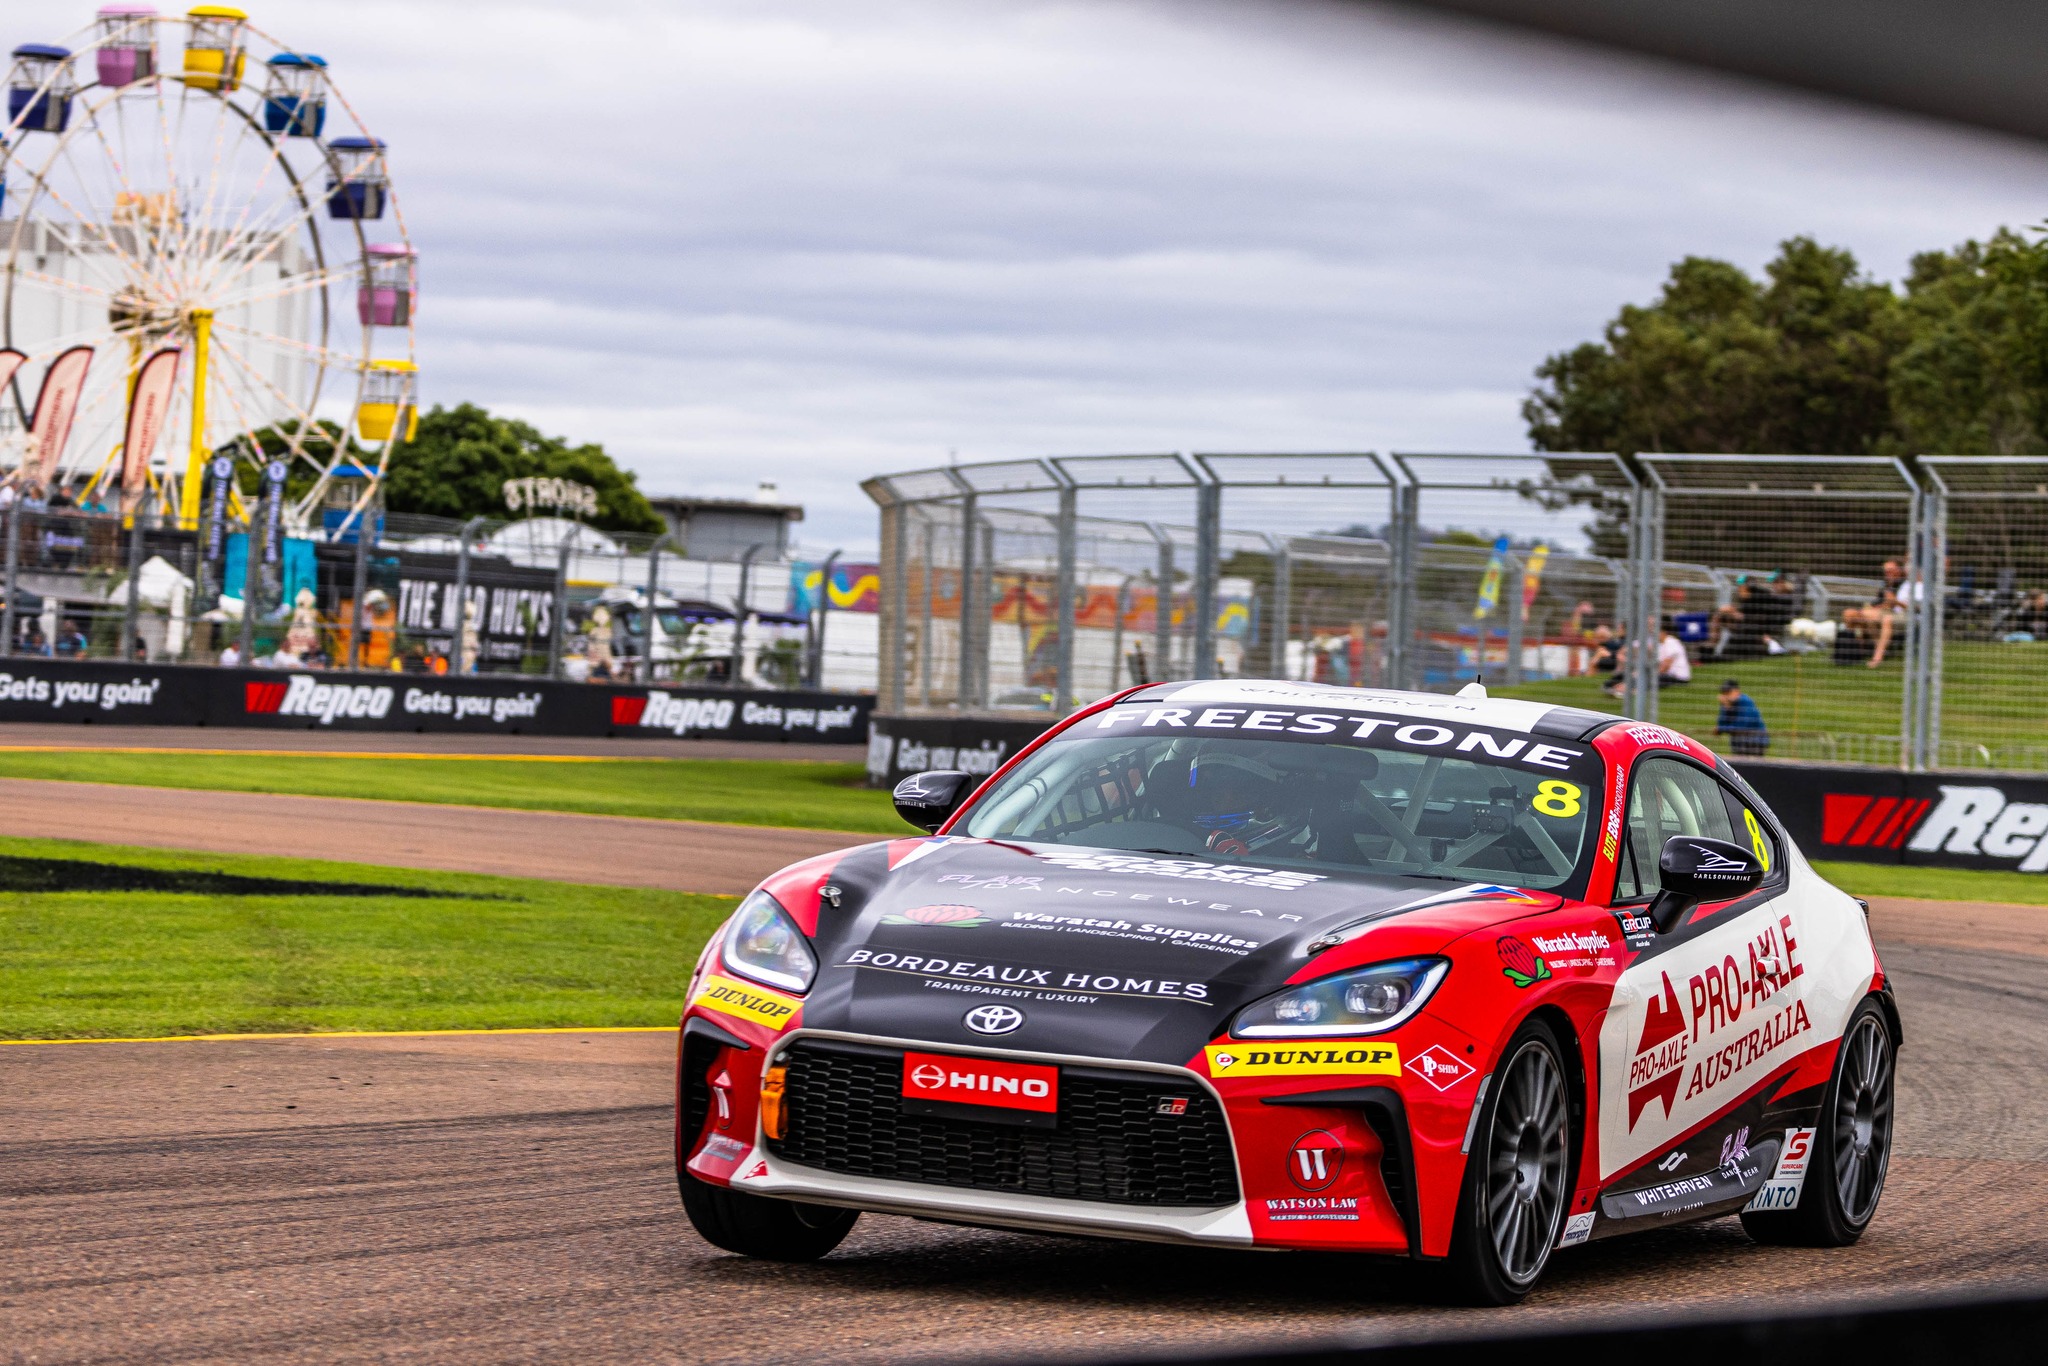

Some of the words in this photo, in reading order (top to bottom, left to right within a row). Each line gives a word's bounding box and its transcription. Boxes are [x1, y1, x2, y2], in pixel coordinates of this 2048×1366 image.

[398, 579, 438, 629] THE
[0, 673, 50, 700] Gets
[52, 680, 98, 708] you
[279, 674, 394, 725] Repco
[404, 687, 451, 712] Gets
[453, 698, 492, 720] you
[640, 690, 736, 735] Repco
[741, 700, 783, 726] Gets
[783, 705, 815, 731] you
[1097, 708, 1584, 770] FREESTONE
[1625, 726, 1690, 751] FREESTONE
[1532, 780, 1582, 818] 8
[1607, 810, 1621, 841] EDGE
[1743, 808, 1769, 872] 8
[1603, 832, 1618, 863] ELITE
[937, 874, 1045, 889] FLAIR
[1693, 873, 1751, 882] CARLSONMARINE
[1001, 921, 1054, 931] BUILDING
[1066, 927, 1157, 942] LANDSCAPING
[1171, 939, 1250, 957] GARDENING
[1013, 911, 1132, 931] Waratah
[1137, 922, 1260, 949] Supplies
[1532, 932, 1573, 953] Waratah
[1574, 930, 1610, 954] Supplies
[846, 949, 1052, 986] BORDEAUX
[1061, 973, 1208, 999] HOMES
[1689, 914, 1804, 1044] PRO-AXLE
[709, 986, 792, 1017] DUNLOP
[924, 979, 1031, 999] TRANSPARENT
[1035, 992, 1098, 1004] LUXURY
[1246, 1050, 1393, 1065] DUNLOP
[1629, 1034, 1688, 1089] PRO-AXLE
[1685, 999, 1811, 1101] AUSTRALIA
[950, 1071, 1049, 1098] HINO
[1437, 1064, 1459, 1075] SHIM
[1157, 1102, 1185, 1114] GR
[1743, 1166, 1759, 1178] WEAR
[1266, 1197, 1327, 1210] WATSON
[1331, 1197, 1358, 1209] LAW
[1635, 1175, 1713, 1206] WHITEHAVEN
